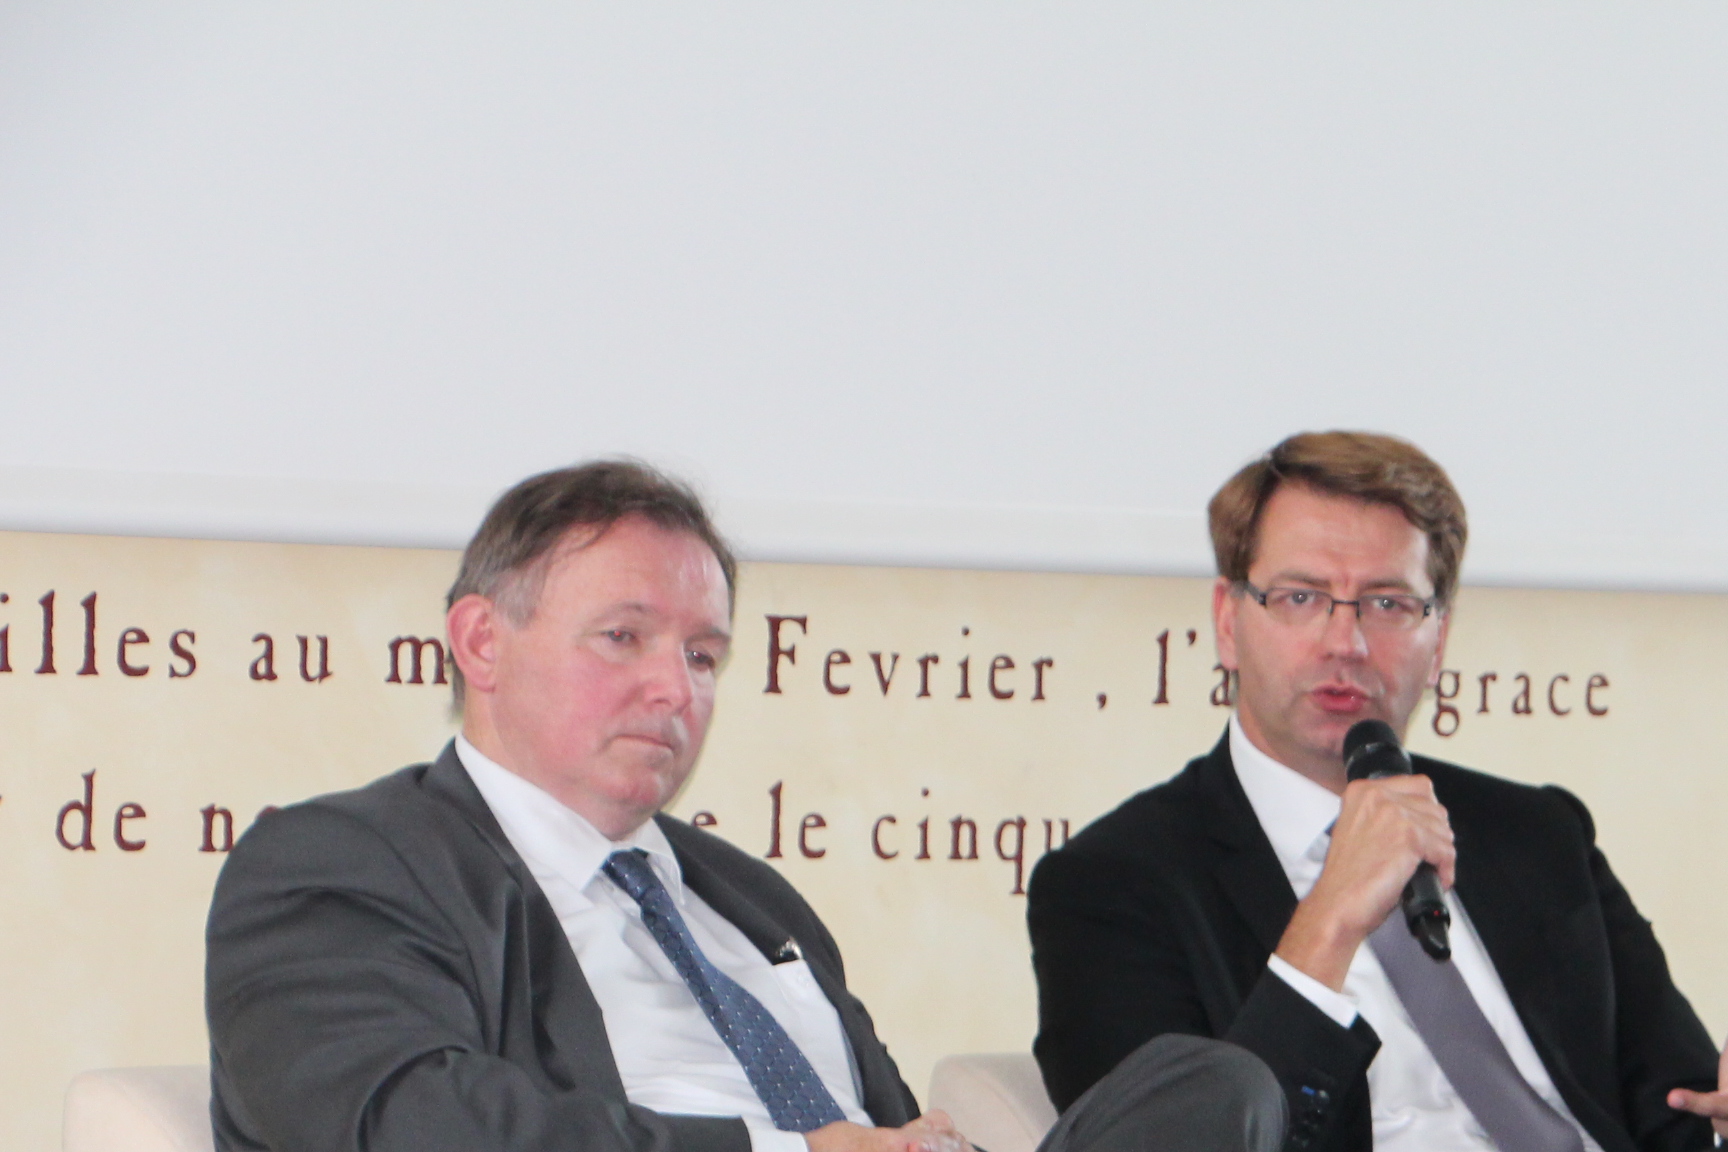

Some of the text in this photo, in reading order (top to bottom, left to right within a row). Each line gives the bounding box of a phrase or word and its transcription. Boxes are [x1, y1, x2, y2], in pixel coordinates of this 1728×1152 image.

[249, 632, 333, 684] au
[385, 634, 450, 685] m
[762, 614, 1054, 701] Fevrier
[1432, 668, 1610, 738] grace
[55, 768, 147, 852] de
[764, 779, 828, 859] le
